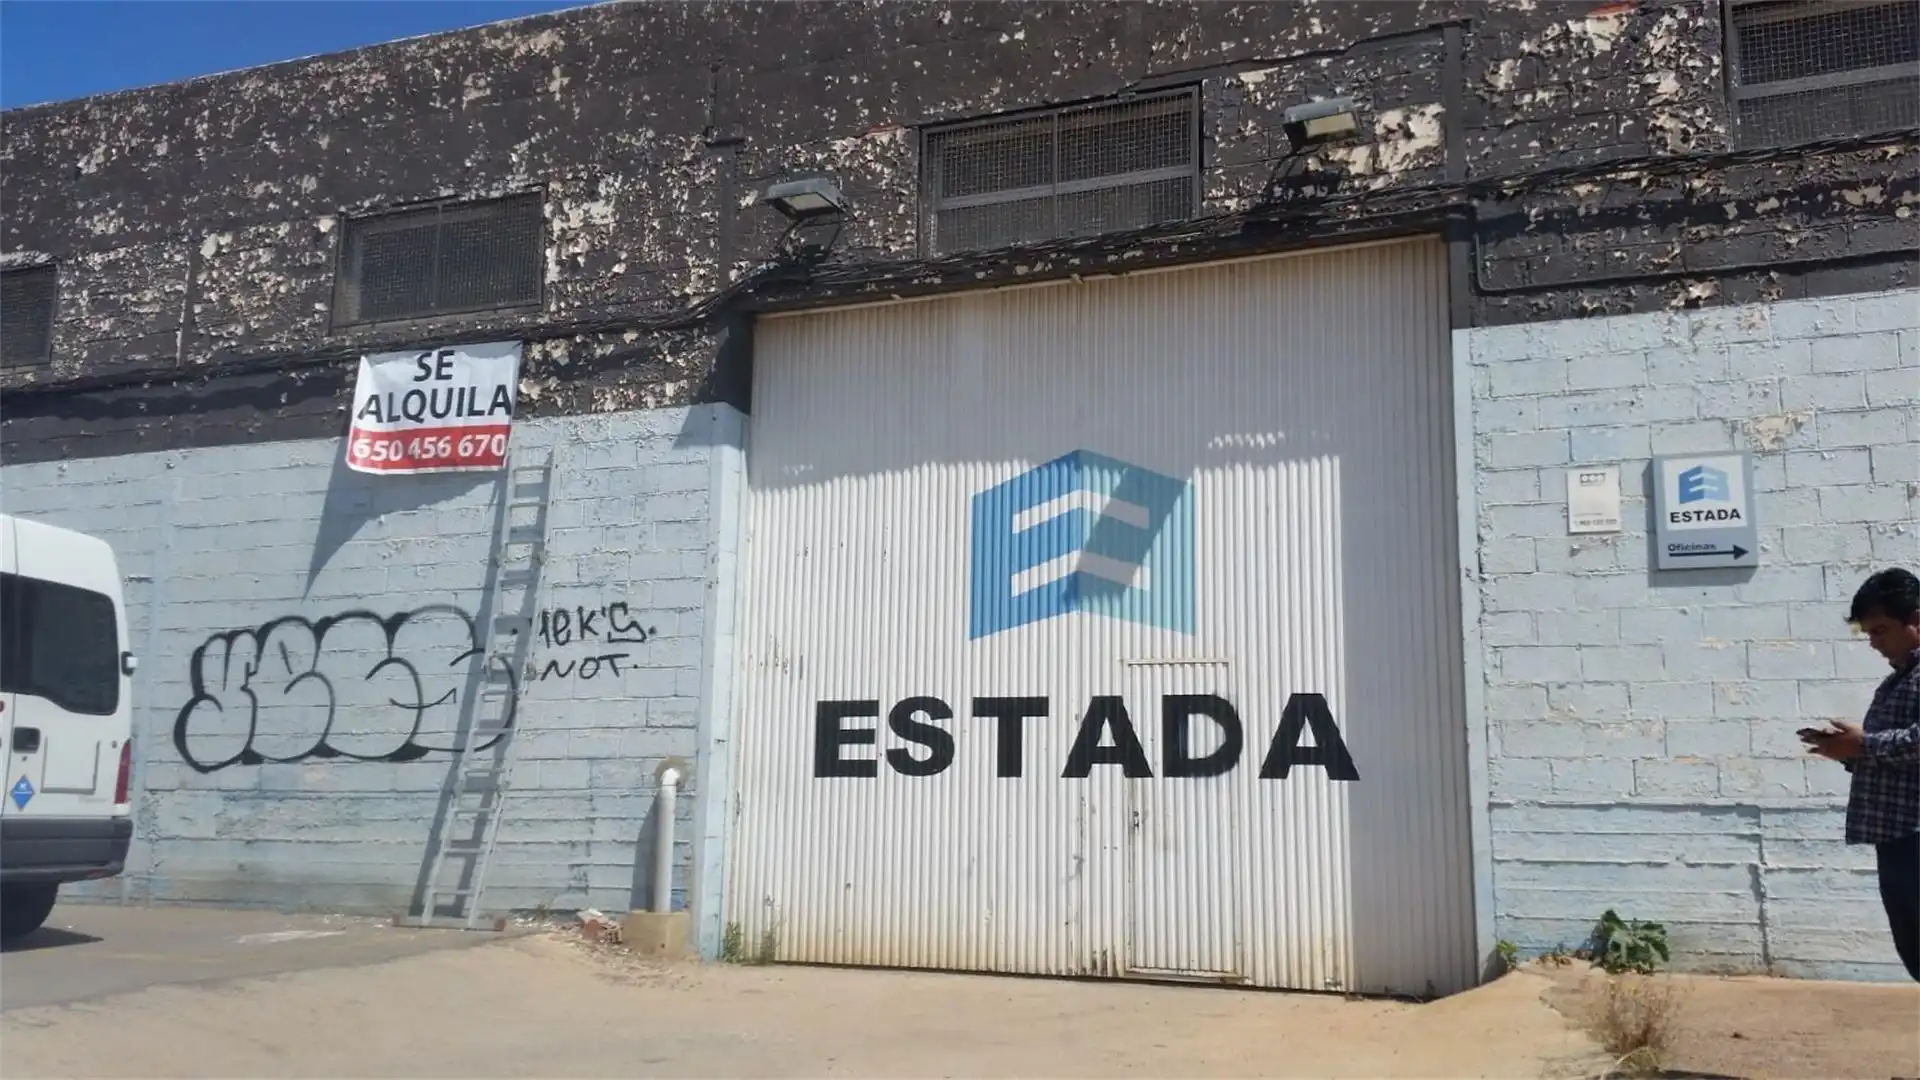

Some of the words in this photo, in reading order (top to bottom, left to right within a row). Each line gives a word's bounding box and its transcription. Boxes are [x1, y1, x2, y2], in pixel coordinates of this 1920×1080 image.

[413, 350, 455, 382] SE
[357, 384, 512, 423] ALQUILA
[352, 438, 403, 461] 650
[408, 436, 452, 459] 456
[458, 434, 506, 457] 670
[1670, 508, 1741, 523] ESTADA
[1668, 543, 1717, 552] Oficinas
[814, 692, 1360, 781] ESTADA
